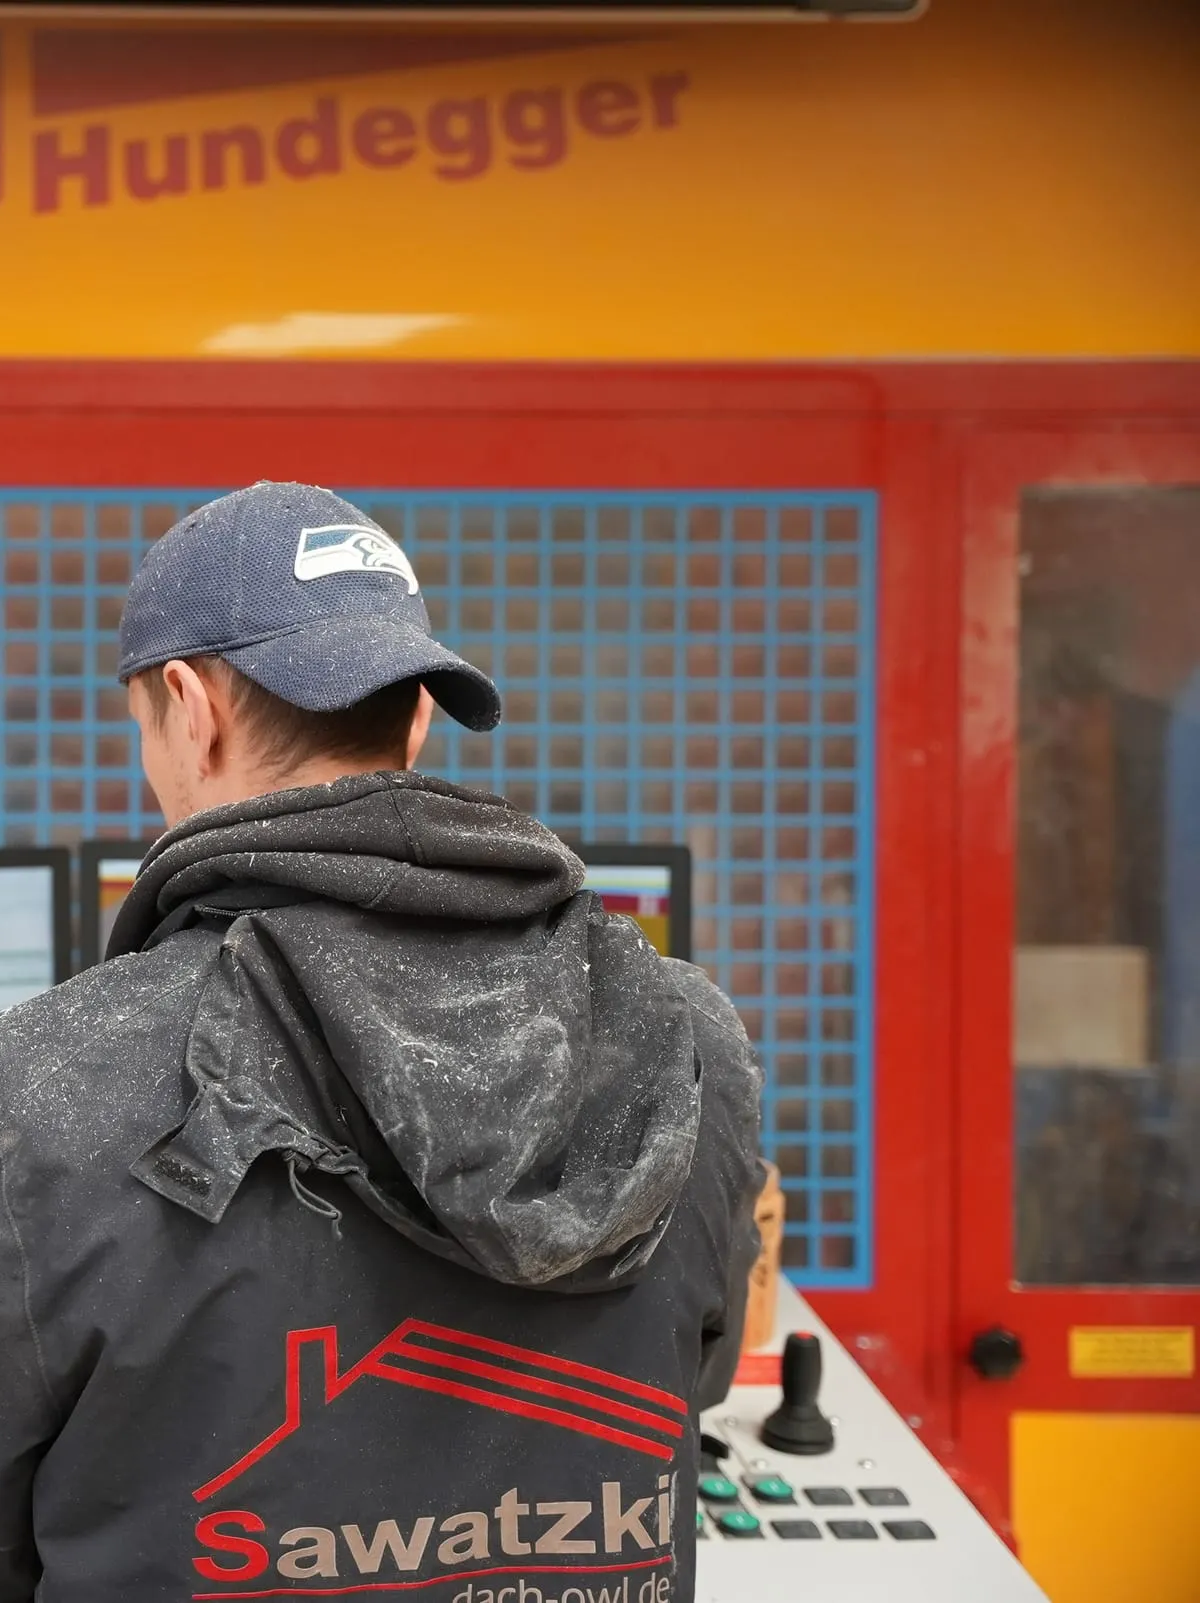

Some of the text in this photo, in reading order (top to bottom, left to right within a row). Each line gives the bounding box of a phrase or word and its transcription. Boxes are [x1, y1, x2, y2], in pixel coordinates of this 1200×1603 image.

[32, 70, 689, 214] Hundegger
[192, 1474, 672, 1581] Sawatzki
[451, 1571, 670, 1603] dach-owlde
